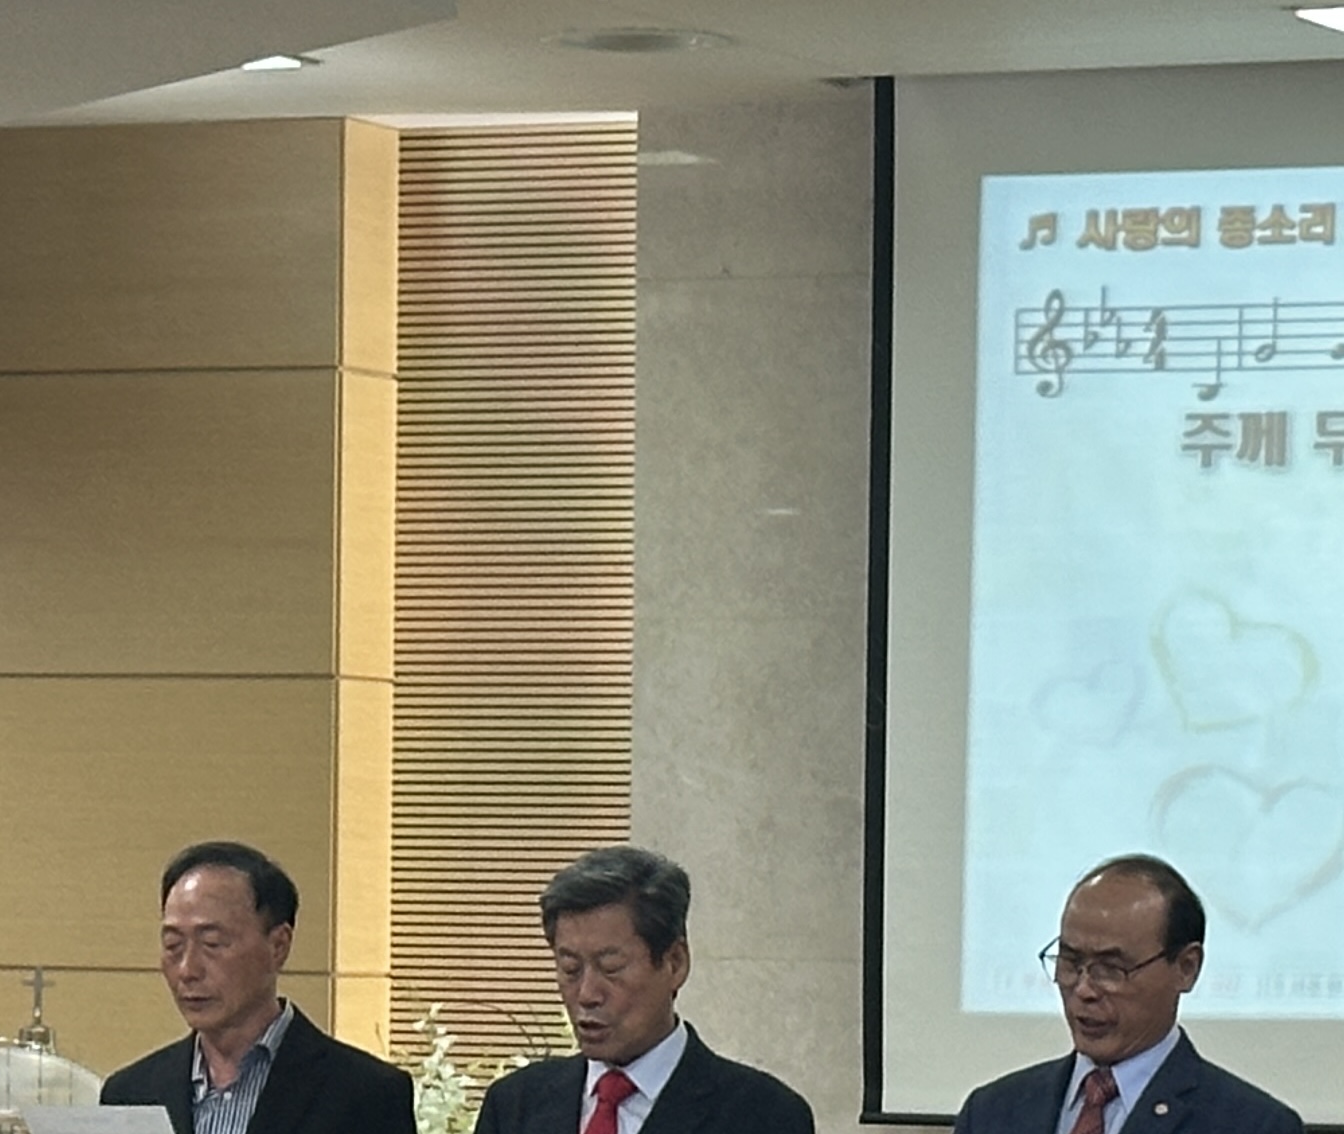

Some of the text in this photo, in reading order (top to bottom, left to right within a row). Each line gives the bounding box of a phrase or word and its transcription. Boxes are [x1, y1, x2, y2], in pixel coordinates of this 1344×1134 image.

[1077, 202, 1337, 251] 사랑의 종소리
[1180, 411, 1288, 469] 주께
